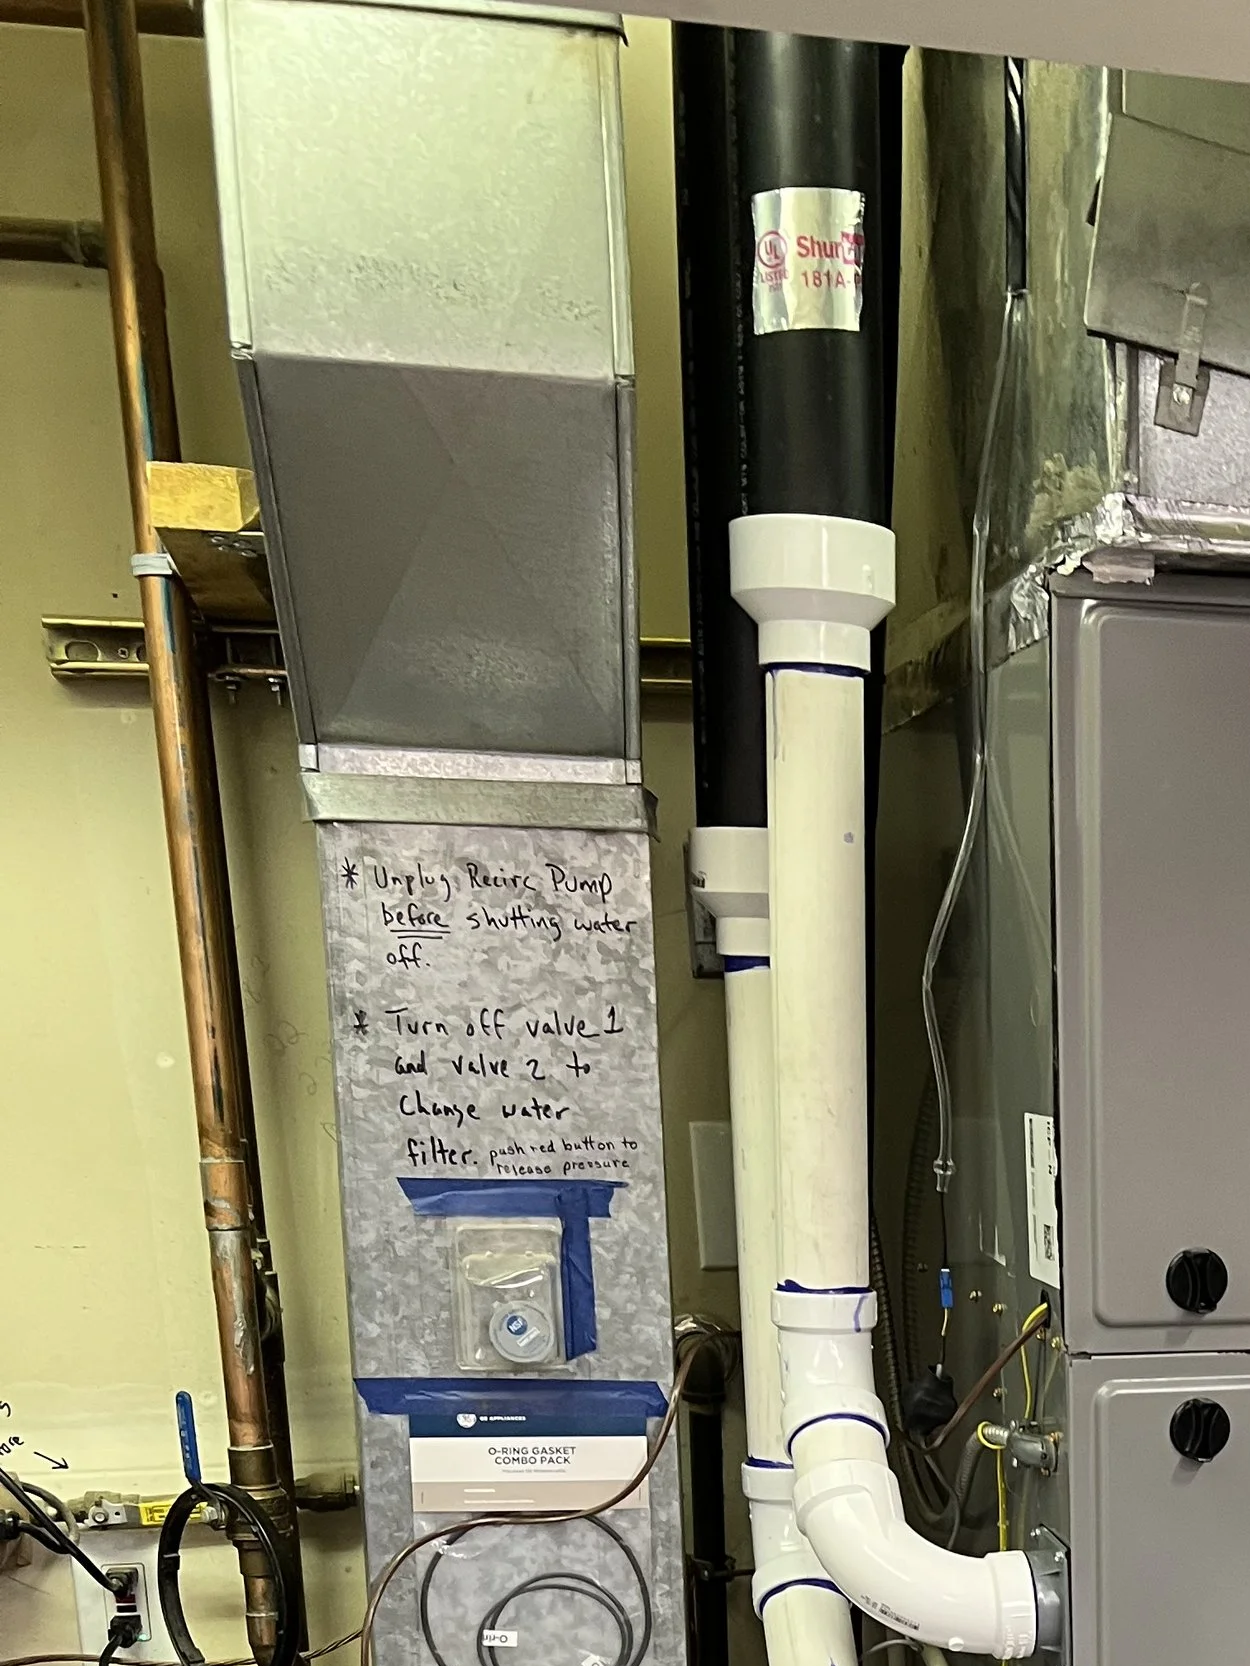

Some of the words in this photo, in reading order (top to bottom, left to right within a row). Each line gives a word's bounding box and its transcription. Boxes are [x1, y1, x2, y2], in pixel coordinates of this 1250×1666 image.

[375, 864, 451, 902] Unplug
[467, 863, 537, 892] Recirc
[545, 863, 613, 903] Pump
[381, 902, 450, 928] before
[466, 904, 561, 942] shutting
[574, 911, 638, 933] water
[385, 1006, 449, 1036] Turn
[466, 1008, 505, 1040] off
[604, 1006, 624, 1034] 1
[395, 1050, 428, 1076] and
[527, 1059, 546, 1081] 2
[566, 1051, 591, 1075] to
[502, 1097, 570, 1121] water
[489, 1143, 527, 1167] push
[531, 1140, 557, 1154] red
[562, 1135, 616, 1152] button
[622, 1137, 638, 1151] to
[497, 1161, 553, 1176] release
[563, 1158, 631, 1176] pressure
[487, 1446, 530, 1457] O-RING
[532, 1445, 577, 1456] GASKET
[494, 1456, 538, 1466] COMBO
[540, 1455, 572, 1466] PACK
